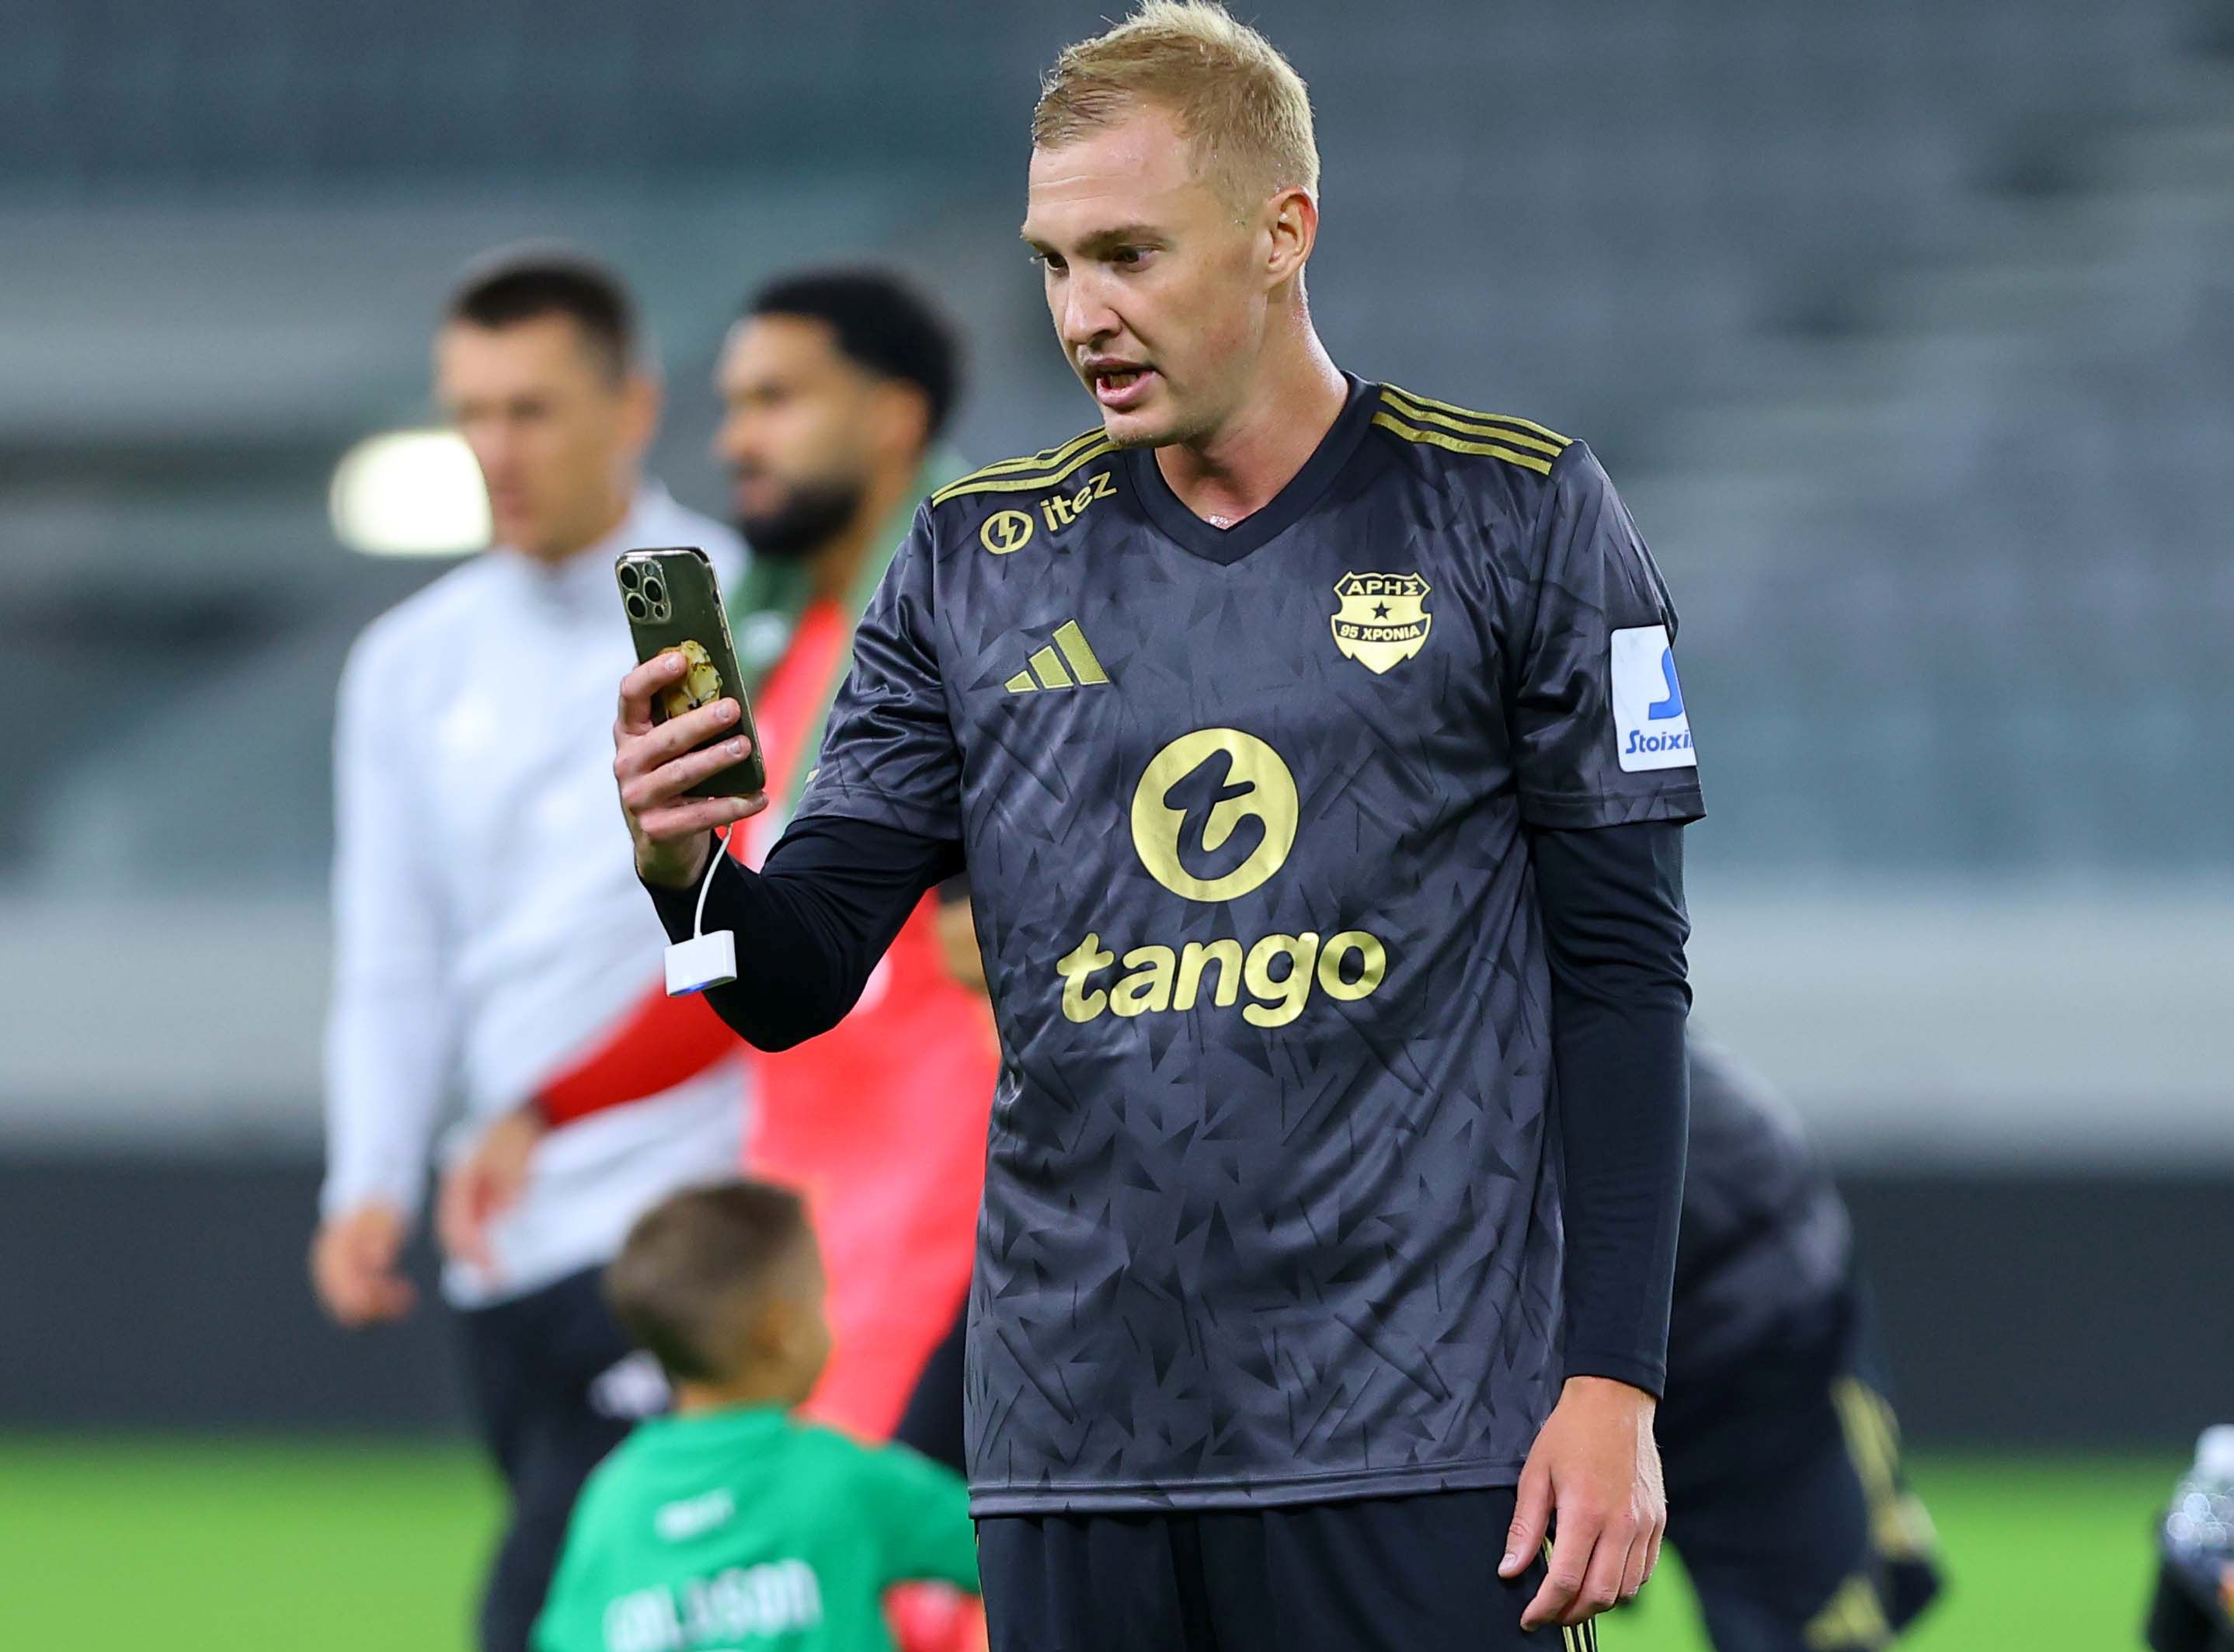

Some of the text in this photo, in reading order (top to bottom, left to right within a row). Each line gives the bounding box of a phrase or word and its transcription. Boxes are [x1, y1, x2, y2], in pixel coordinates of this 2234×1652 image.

[1040, 471, 1118, 531] itez
[1345, 579, 1418, 596] ΑΡΗΣ
[1361, 624, 1421, 641] ΧΡΟΝΙΑ
[1625, 729, 1693, 754] Stoixi
[1056, 930, 1387, 1028] tango
